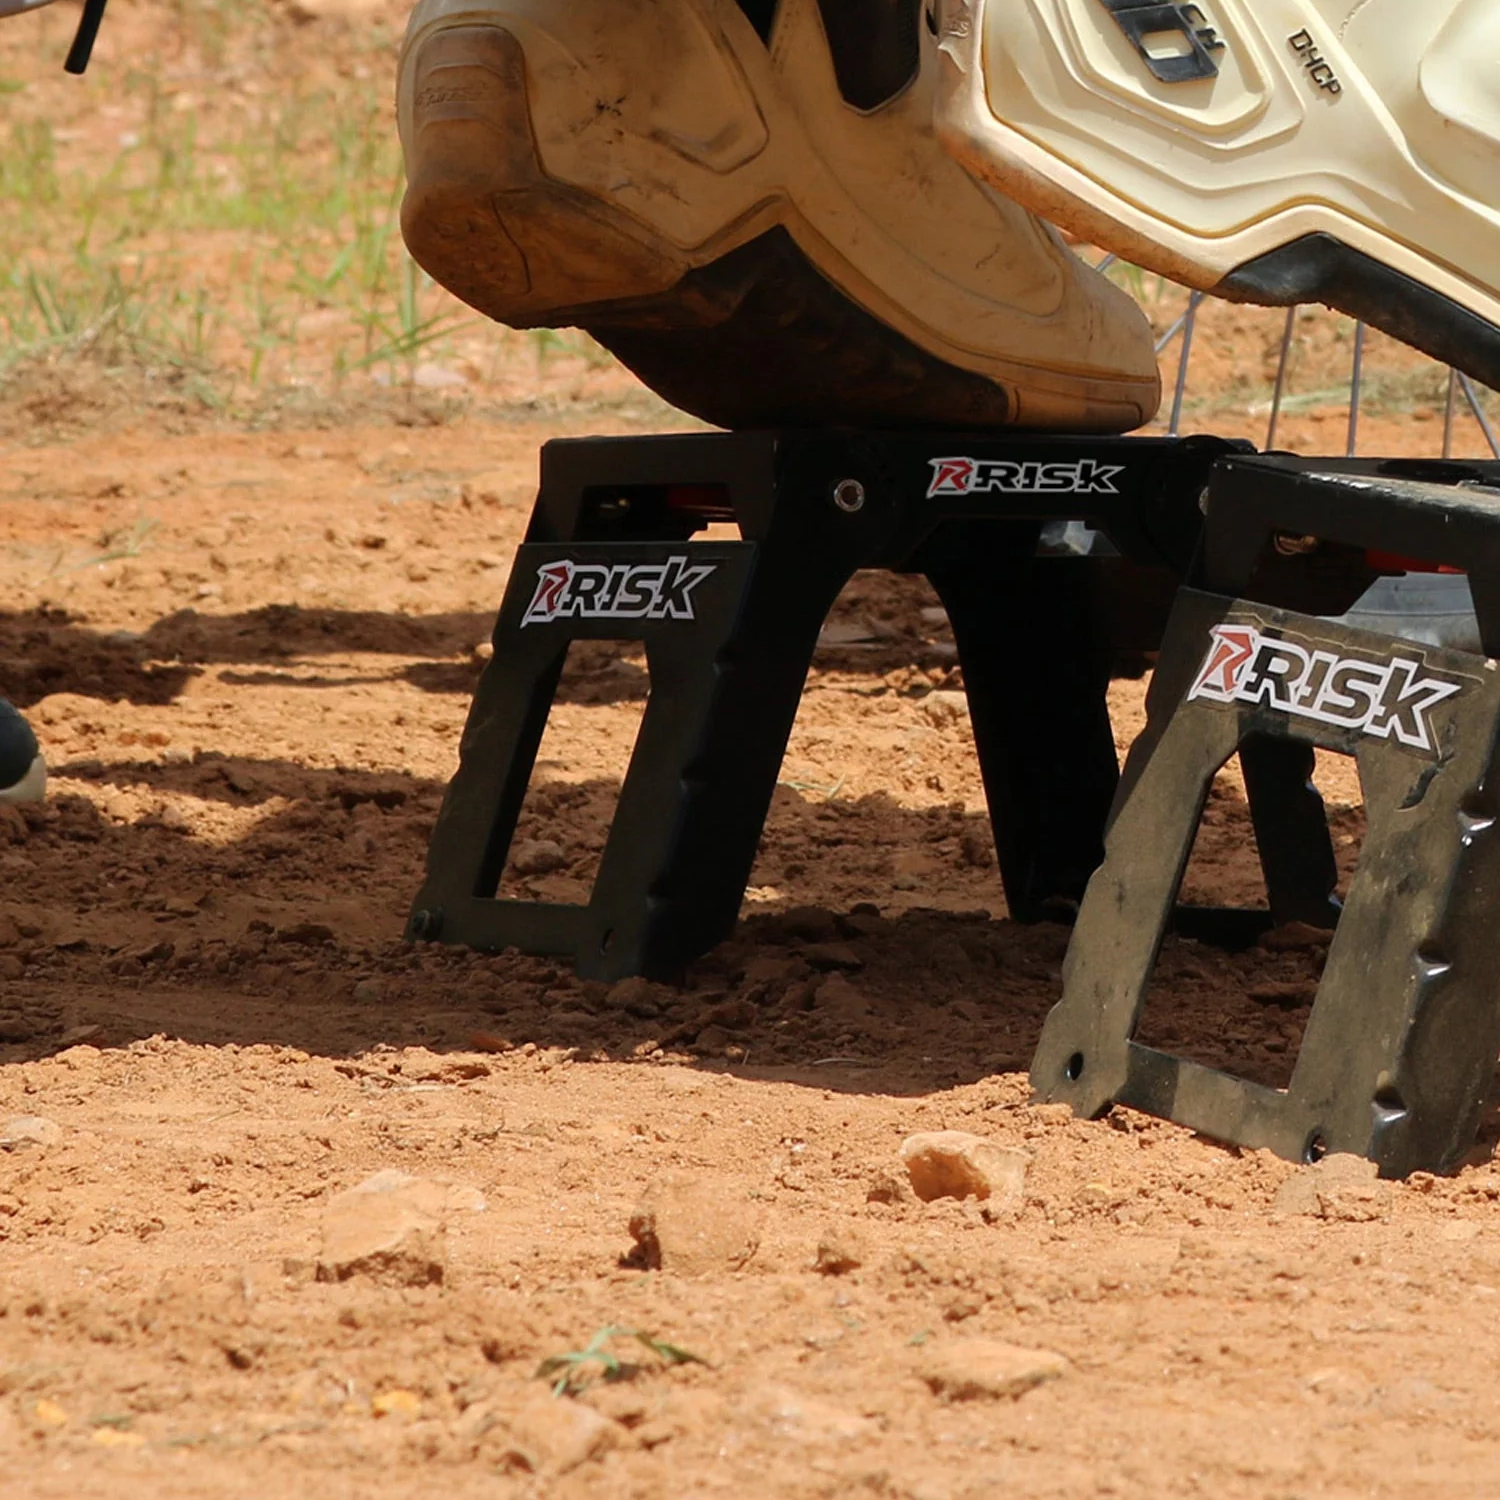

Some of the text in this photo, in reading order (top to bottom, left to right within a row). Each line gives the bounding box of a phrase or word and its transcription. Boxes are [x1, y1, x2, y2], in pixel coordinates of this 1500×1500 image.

[1288, 28, 1341, 95] DHCP
[973, 459, 1126, 493] RISK
[561, 556, 717, 619] RISK
[1237, 636, 1462, 750] RISK
